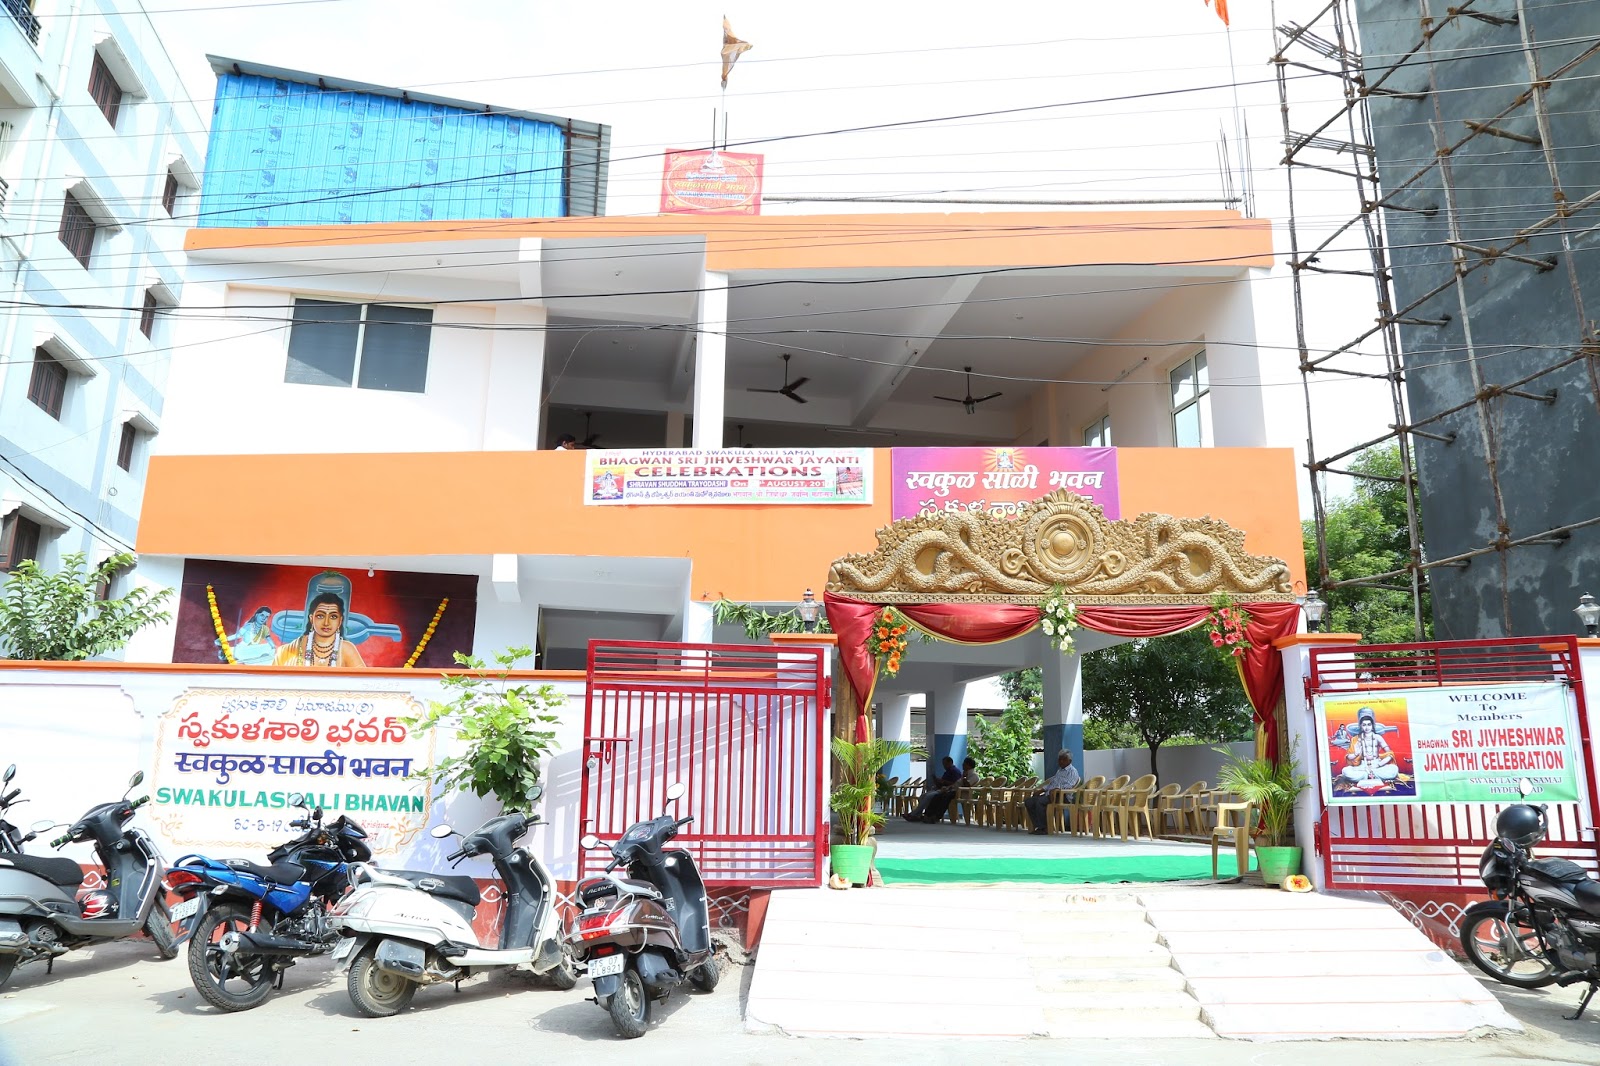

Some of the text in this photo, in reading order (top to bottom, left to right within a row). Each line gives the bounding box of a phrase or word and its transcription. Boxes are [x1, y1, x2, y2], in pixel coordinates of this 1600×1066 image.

[600, 456, 859, 466] BHAGWAN SRI JIHVESHWAR JAYANTI
[634, 466, 822, 477] CELEBRATIONS
[629, 480, 657, 488] SHRAVAN
[906, 464, 1105, 497] स्वकुळ साळी भवन
[1449, 692, 1527, 703] WELCOME
[1479, 703, 1497, 711] To
[1457, 712, 1523, 722] Members
[326, 716, 407, 748] భవన్
[1417, 726, 1566, 749] BHAGWAN SRI JIVHESHWAR
[1423, 750, 1564, 772] JAYANTHI CELEBRATION
[349, 757, 414, 778] भवन
[1490, 786, 1543, 794] HYDERAD
[155, 787, 425, 813] SWAKULASALI BHAVAN
[591, 964, 621, 976] FL8921
